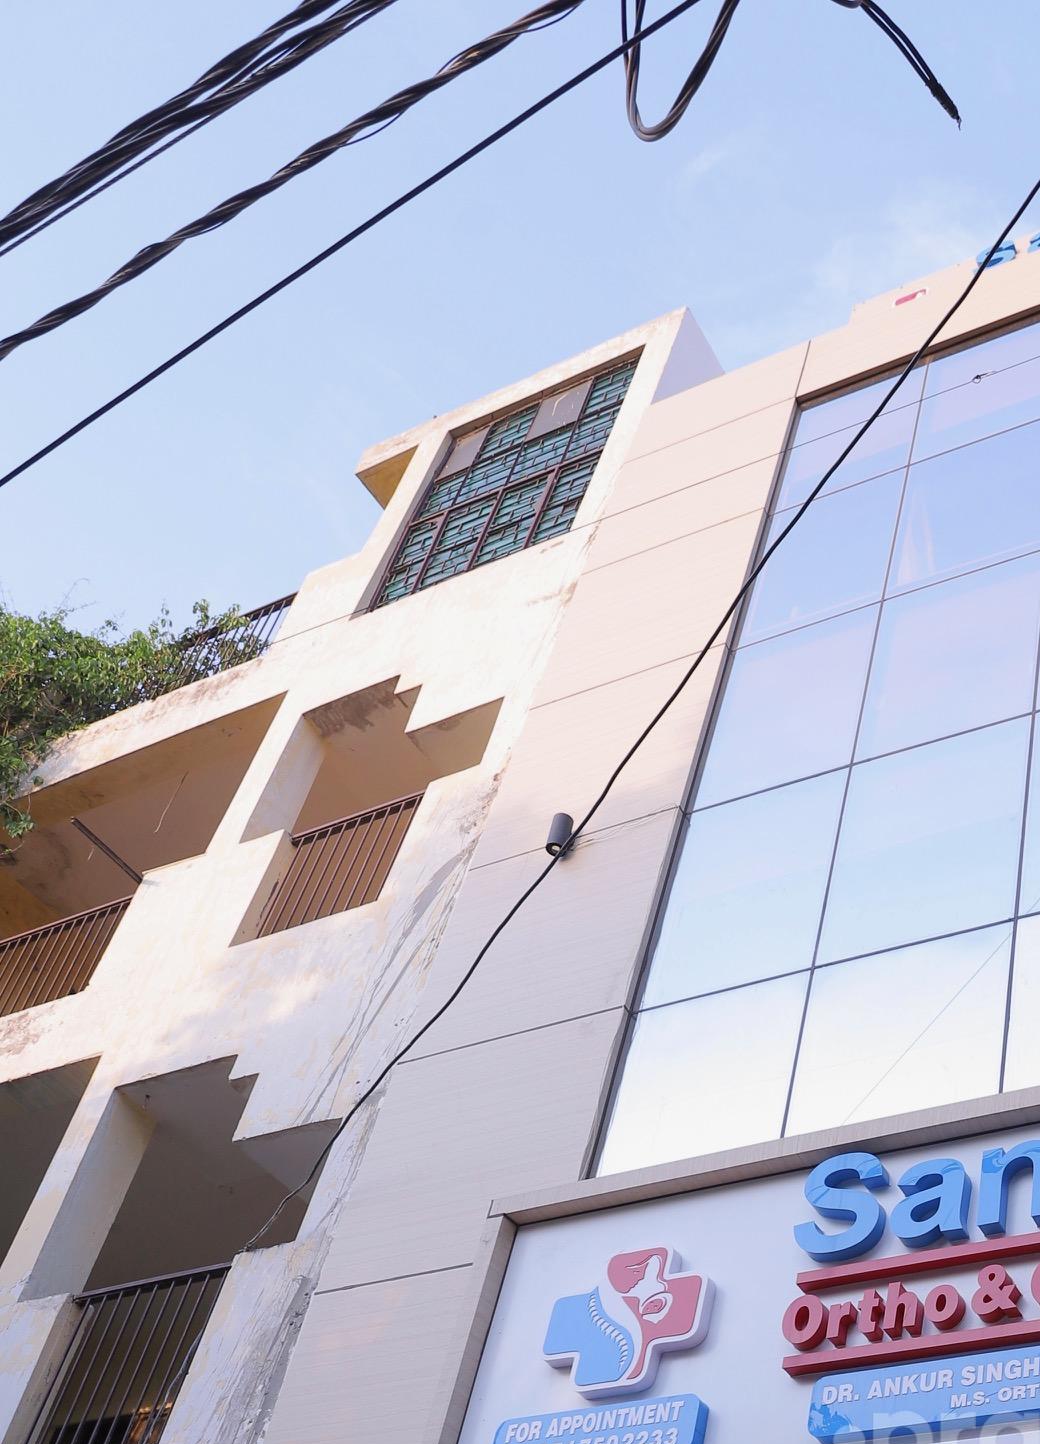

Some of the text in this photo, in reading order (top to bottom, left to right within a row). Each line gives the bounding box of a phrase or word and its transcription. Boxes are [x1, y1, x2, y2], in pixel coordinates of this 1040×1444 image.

[782, 1280, 964, 1351] Ortho
[971, 1264, 1022, 1323] &
[821, 1383, 860, 1406] DR.
[868, 1369, 953, 1400] ANKUR
[950, 1388, 990, 1409] M.S.
[505, 1400, 685, 1443] FOR APPOINTMENT
